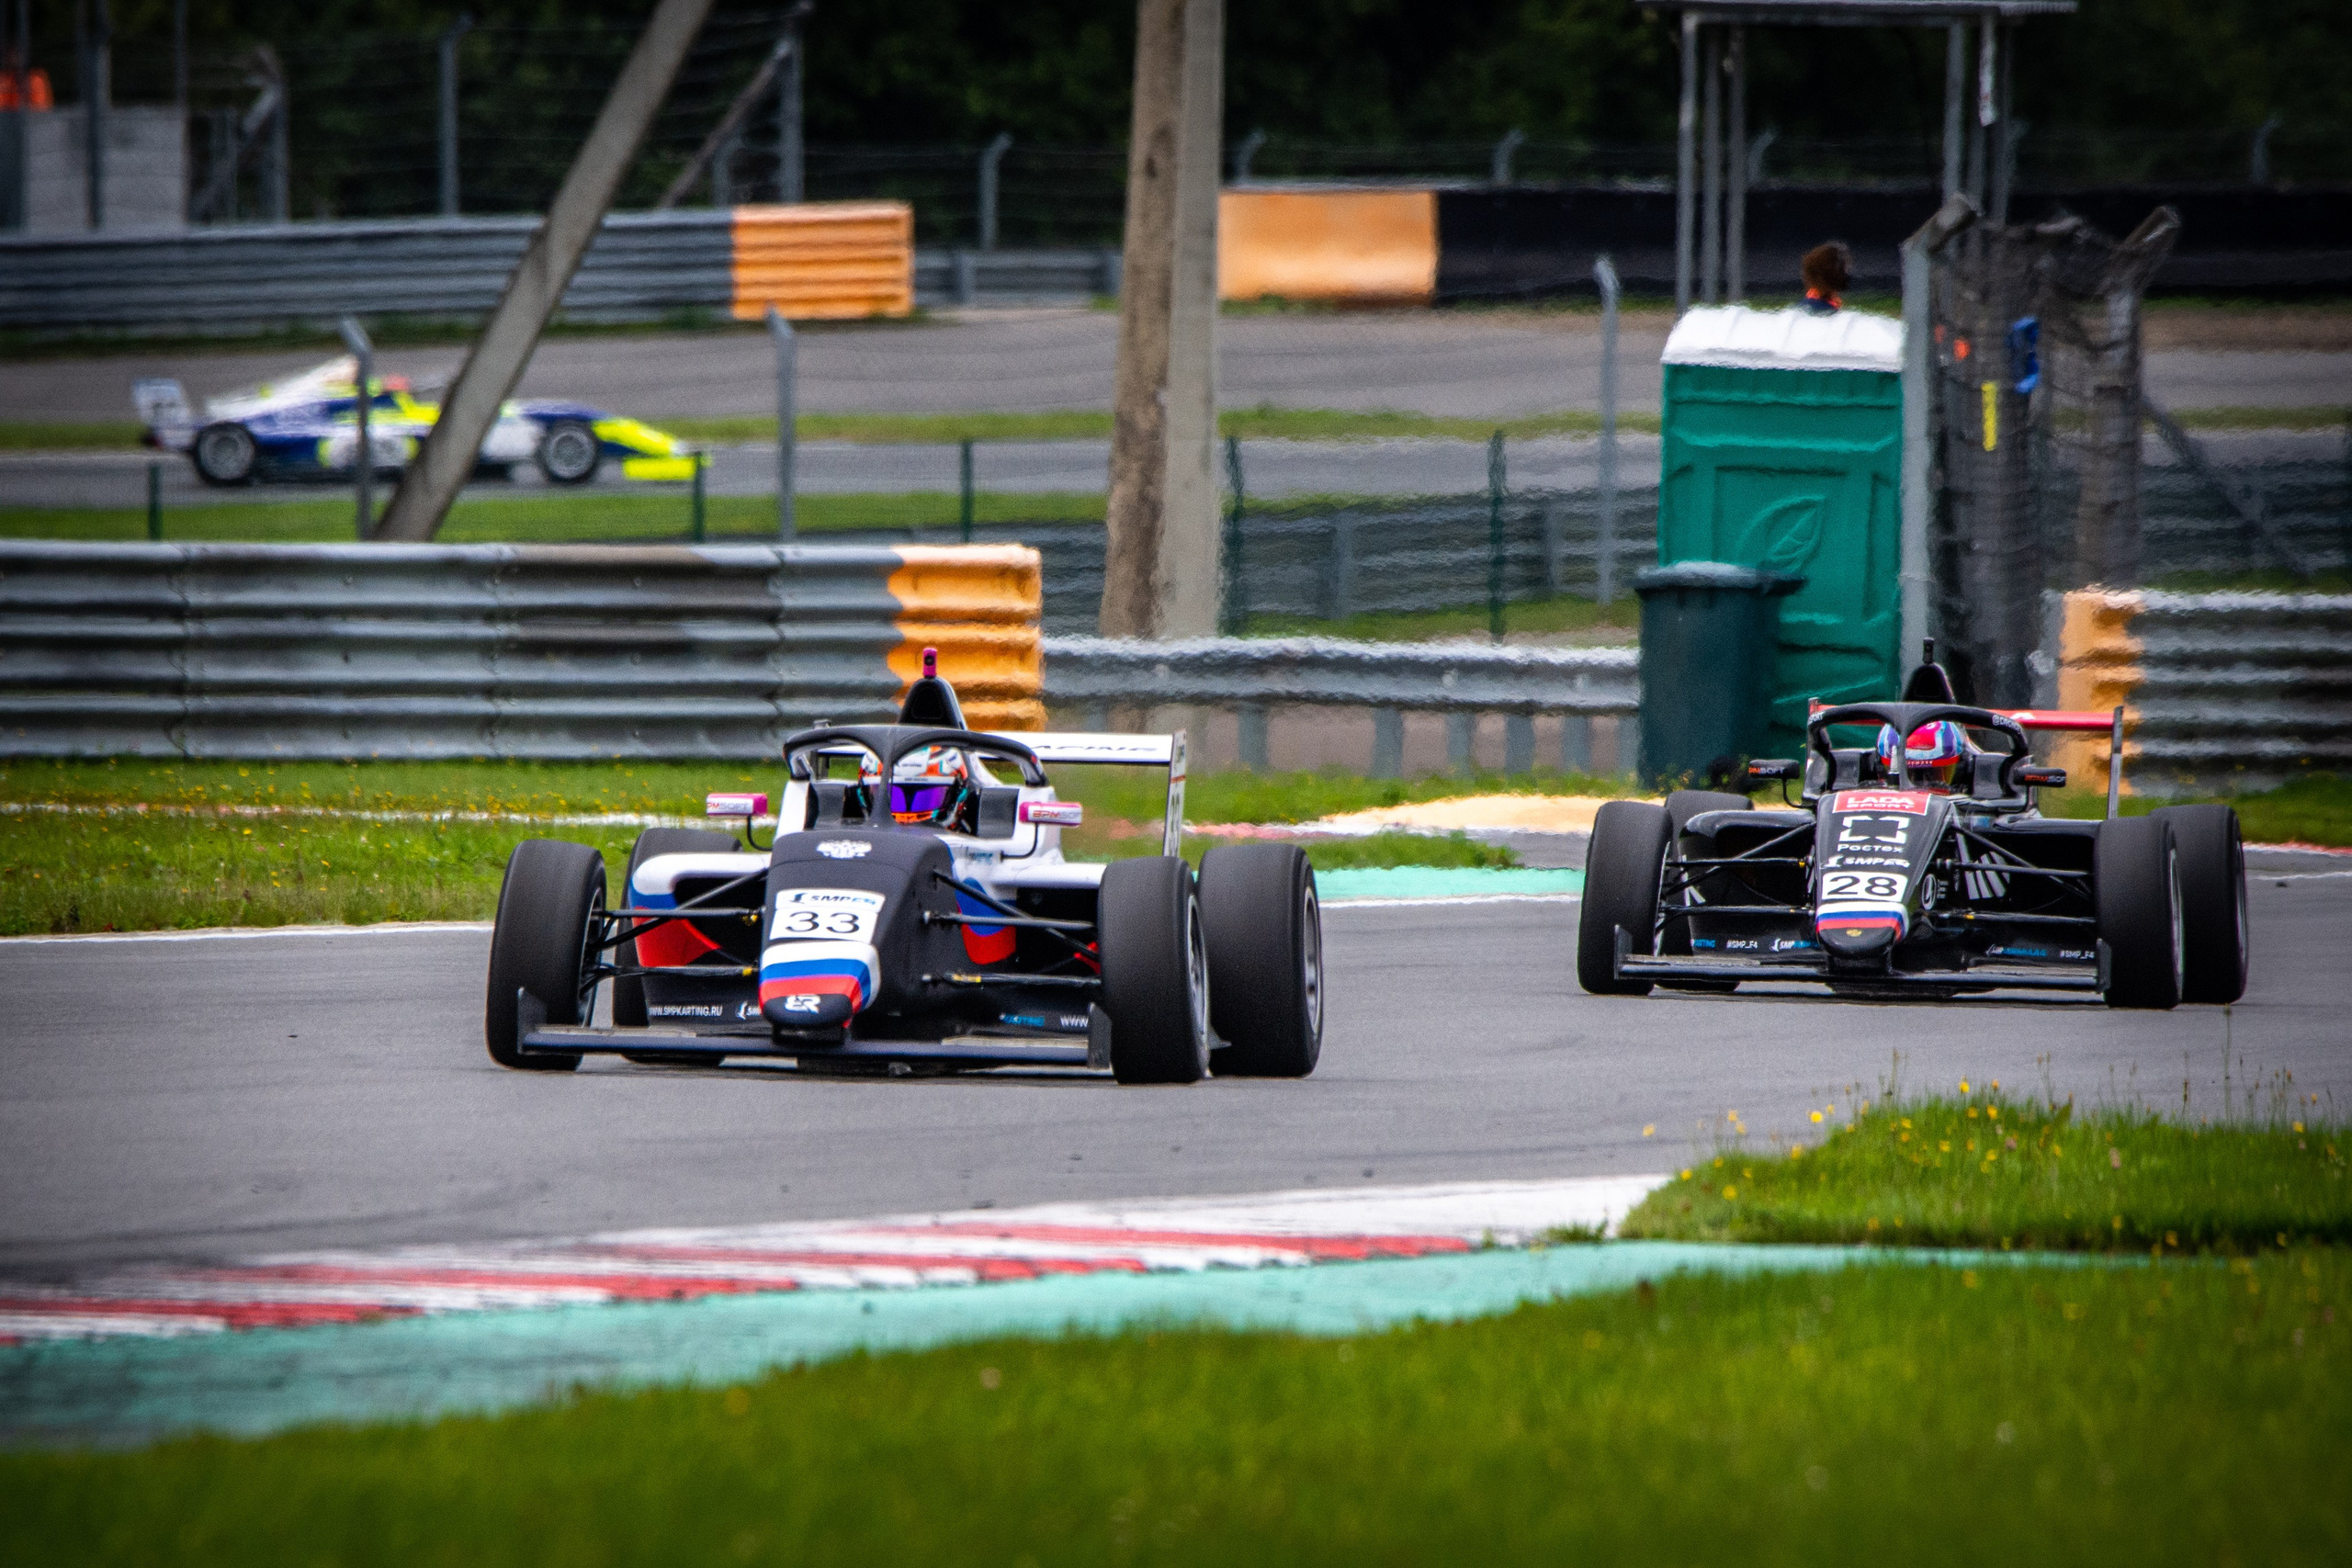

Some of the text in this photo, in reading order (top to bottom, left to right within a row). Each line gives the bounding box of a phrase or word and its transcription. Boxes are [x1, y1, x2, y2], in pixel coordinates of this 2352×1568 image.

[1847, 796, 1915, 805] LADA
[1826, 875, 1898, 897] 28
[785, 910, 860, 934] 33
